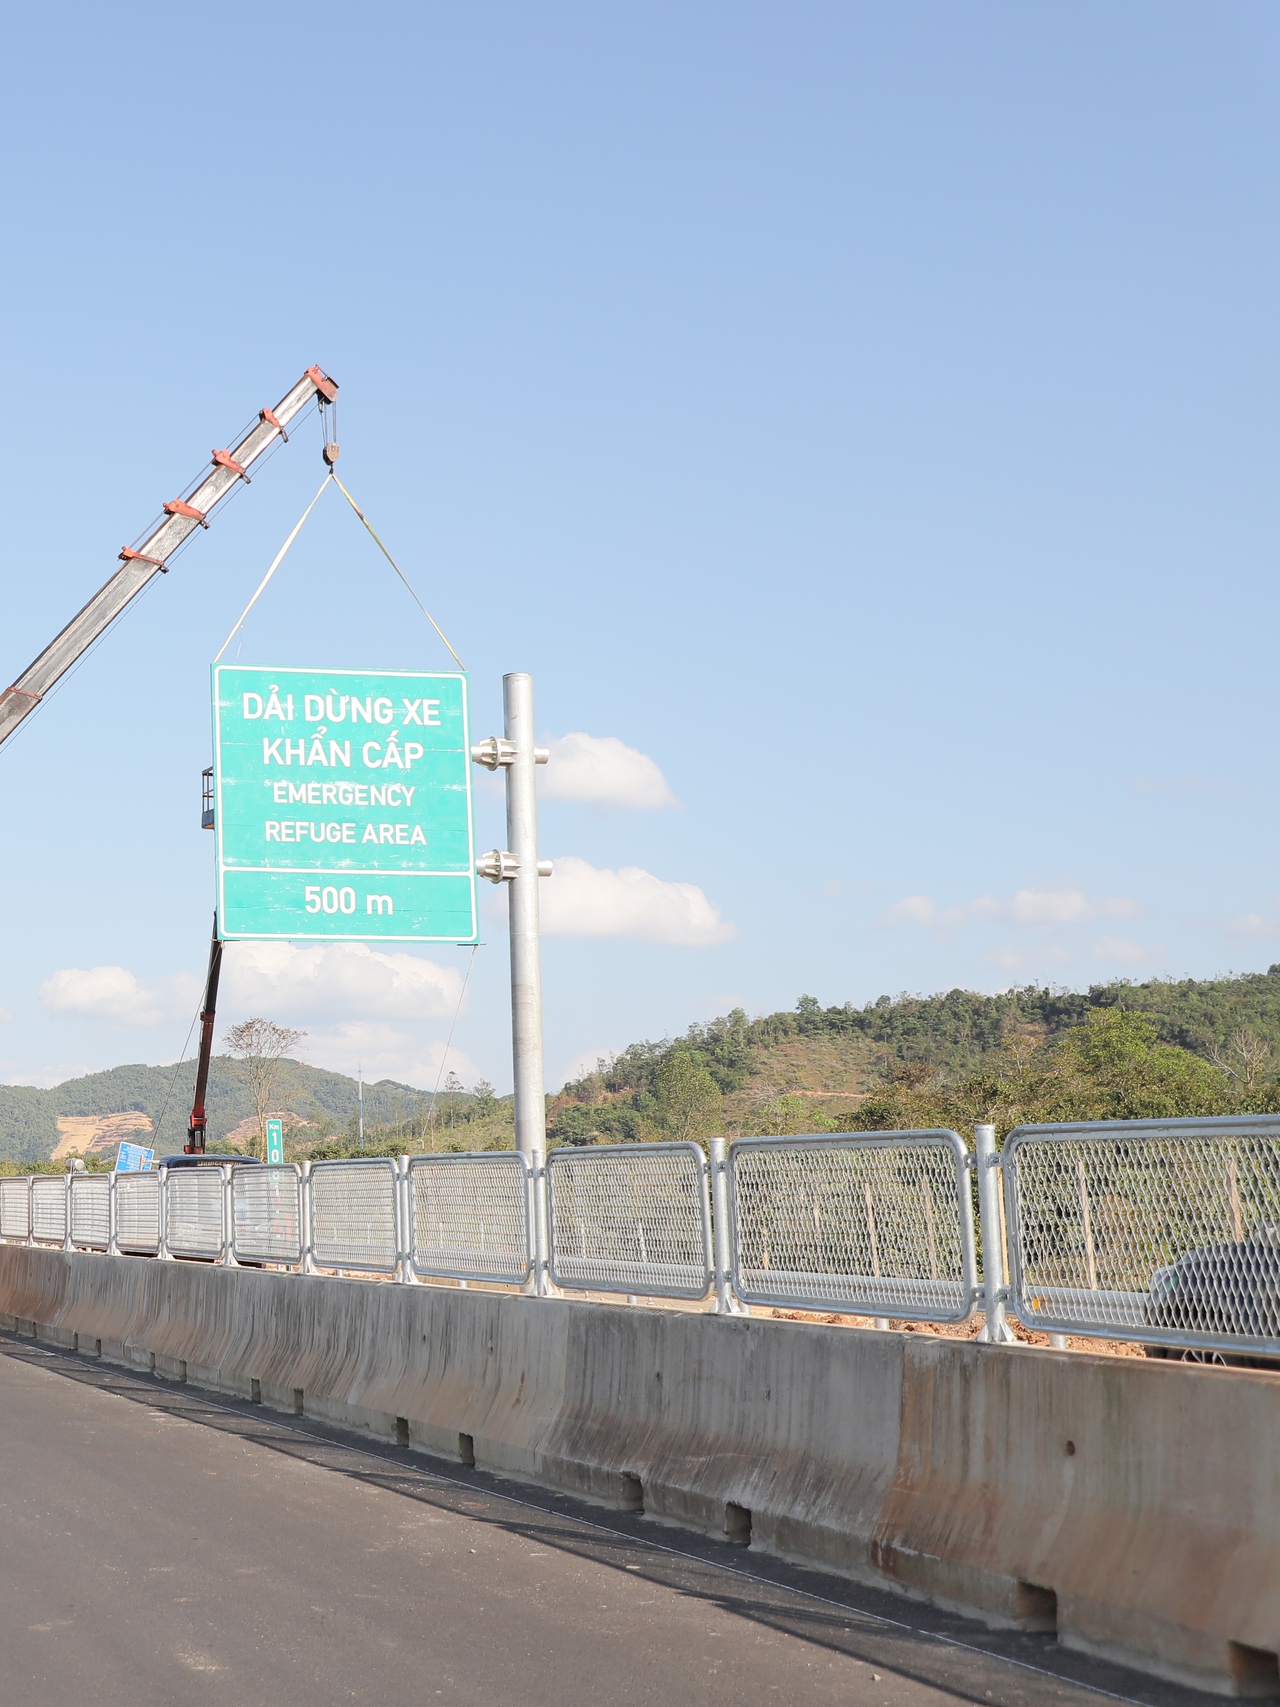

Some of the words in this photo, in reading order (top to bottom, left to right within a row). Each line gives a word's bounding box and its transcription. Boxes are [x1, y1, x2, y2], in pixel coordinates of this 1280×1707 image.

[243, 684, 294, 721] DẢI
[304, 688, 394, 725] DỪNG
[402, 698, 441, 726] XE
[262, 725, 351, 768] KHẨN
[362, 730, 424, 769] CẤP
[273, 782, 416, 807] EMERGENCY
[265, 820, 357, 844] REFUGE
[361, 823, 427, 846] AREA
[305, 886, 357, 914] 500
[366, 894, 394, 916] m
